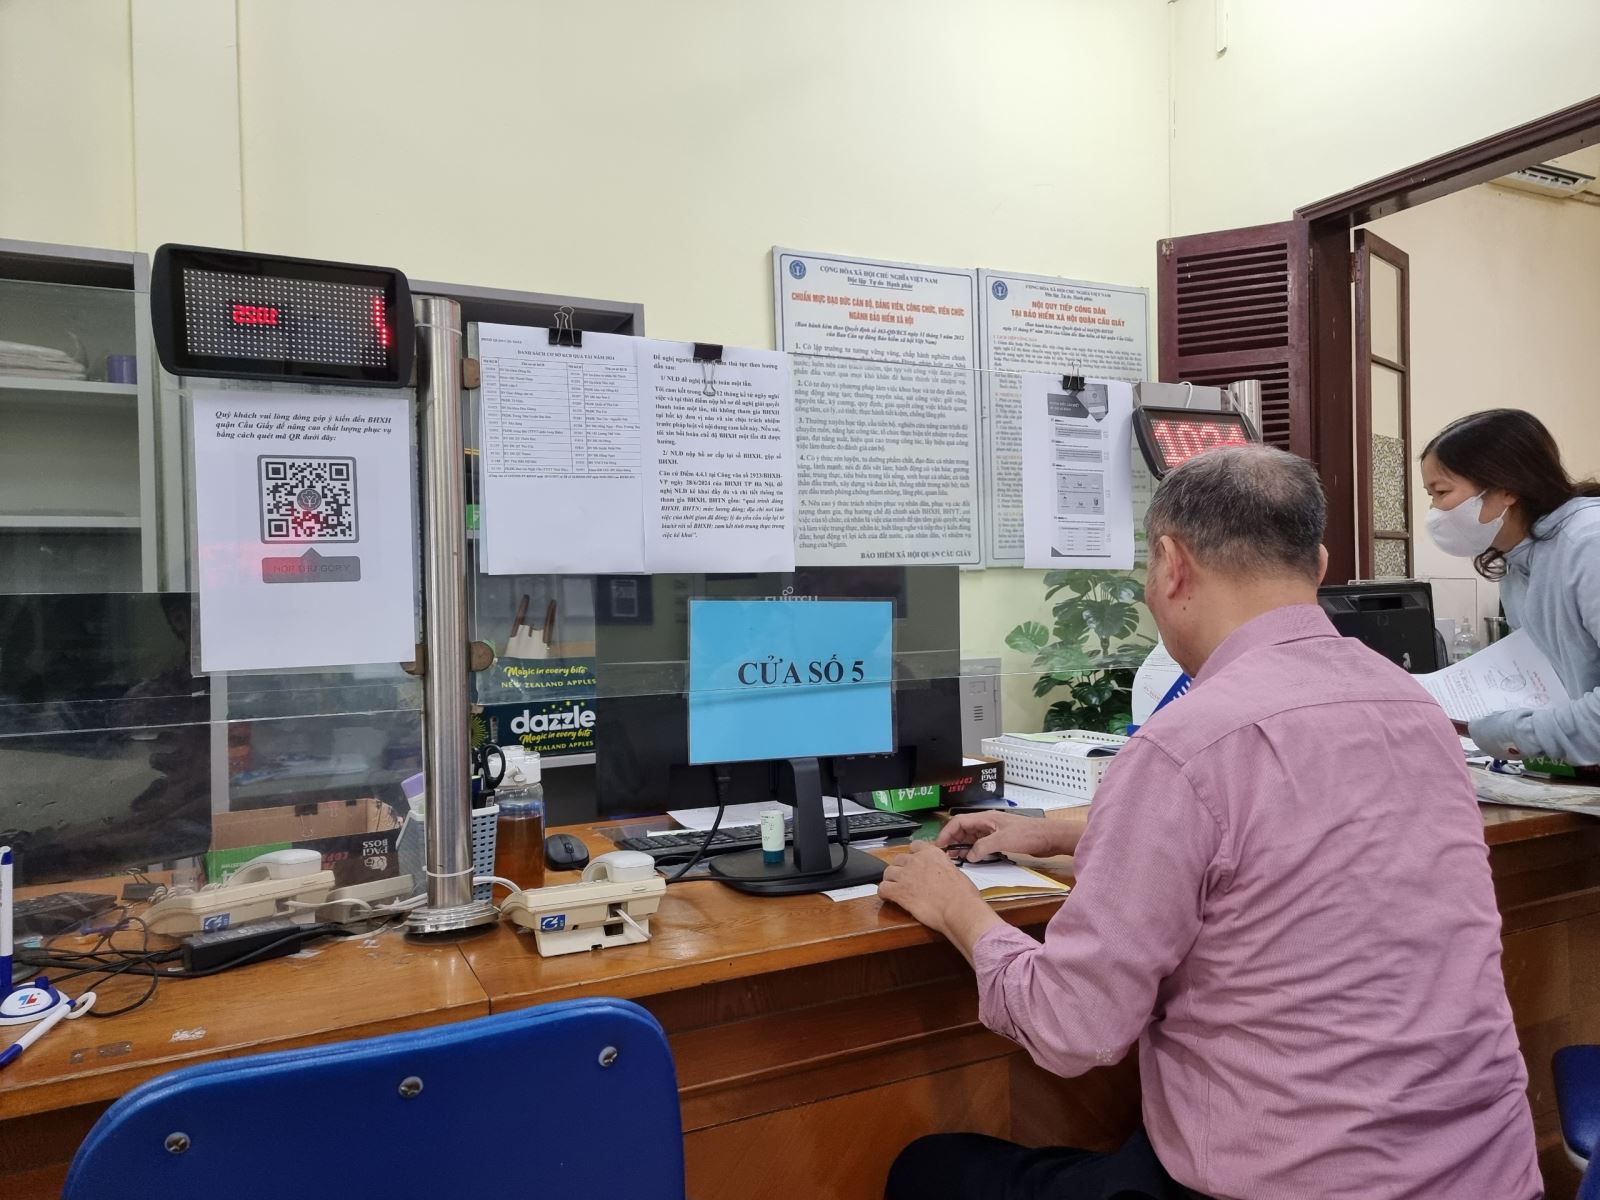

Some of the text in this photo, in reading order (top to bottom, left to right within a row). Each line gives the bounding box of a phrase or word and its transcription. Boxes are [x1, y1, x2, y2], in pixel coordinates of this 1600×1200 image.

[215, 411, 231, 419] Quý
[234, 411, 257, 419] khách
[273, 413, 290, 421] lòng
[292, 413, 311, 422] đóng
[312, 415, 326, 423] góp
[328, 415, 333, 423] ý
[334, 414, 350, 422] kiến
[352, 415, 365, 423] đến
[368, 416, 392, 424] BHXH
[215, 421, 235, 429] quận
[238, 420, 253, 429] Cầu
[256, 421, 274, 430] Giấy
[276, 421, 285, 430] để
[287, 424, 306, 432] nâng
[323, 423, 339, 431] chất
[340, 425, 361, 433] lượng
[363, 426, 381, 434] phục
[216, 429, 235, 439] bằng
[237, 431, 254, 439] cách
[257, 432, 273, 440] quét
[289, 433, 301, 441] QR
[303, 433, 320, 441] dưới
[321, 434, 336, 442] đây:
[503, 665, 588, 677] Magic in every bite
[737, 653, 864, 685] CỬA SỐ 5
[525, 681, 564, 689] ZEALAND
[567, 678, 597, 687] APPLES
[510, 705, 596, 734] dazzle
[518, 728, 592, 744] Magic in every bite
[534, 744, 567, 752] ZEALAND
[568, 740, 594, 748] APPLES
[362, 838, 388, 848] BOSS
[362, 847, 388, 856] PAGI
